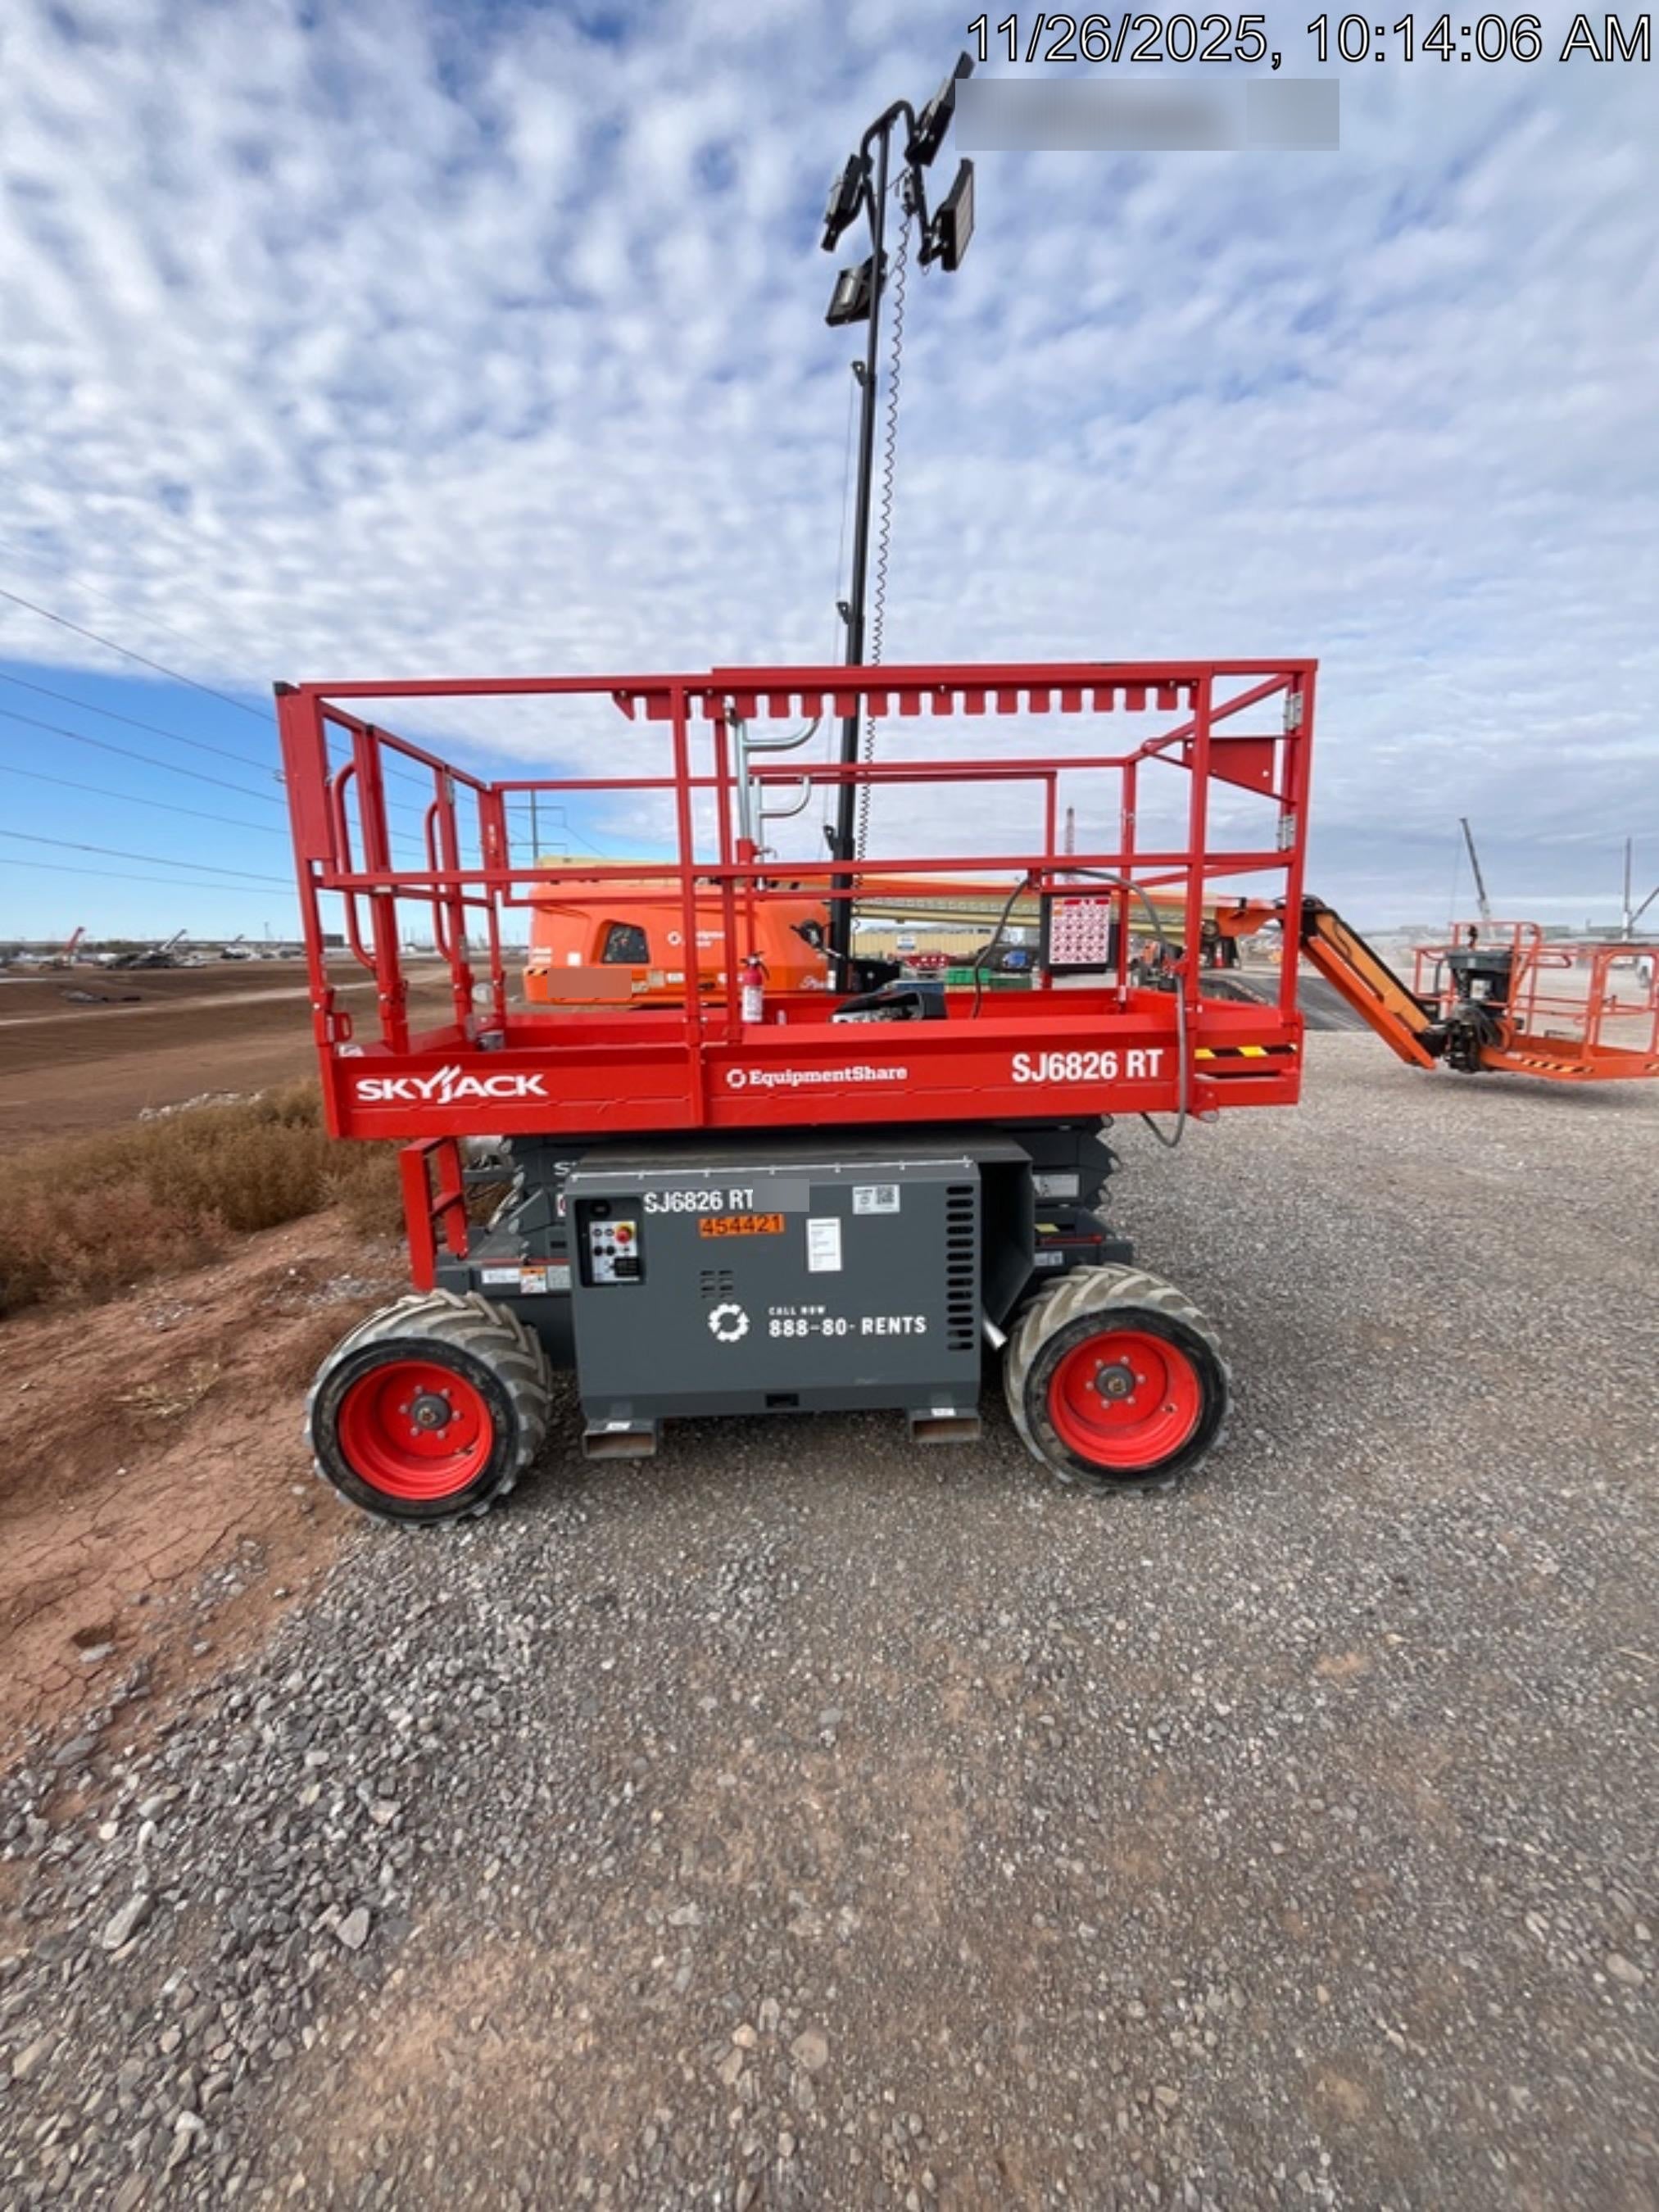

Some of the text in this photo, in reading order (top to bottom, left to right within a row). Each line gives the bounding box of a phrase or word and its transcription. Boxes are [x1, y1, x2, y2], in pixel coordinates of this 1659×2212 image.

[749, 1066, 908, 1087] EquipmentShare
[1012, 1049, 1163, 1082] SJ6826 RT
[356, 1065, 548, 1104] SKYJACK
[644, 1189, 754, 1213] SJ6826 RT
[701, 1215, 783, 1235] 454421
